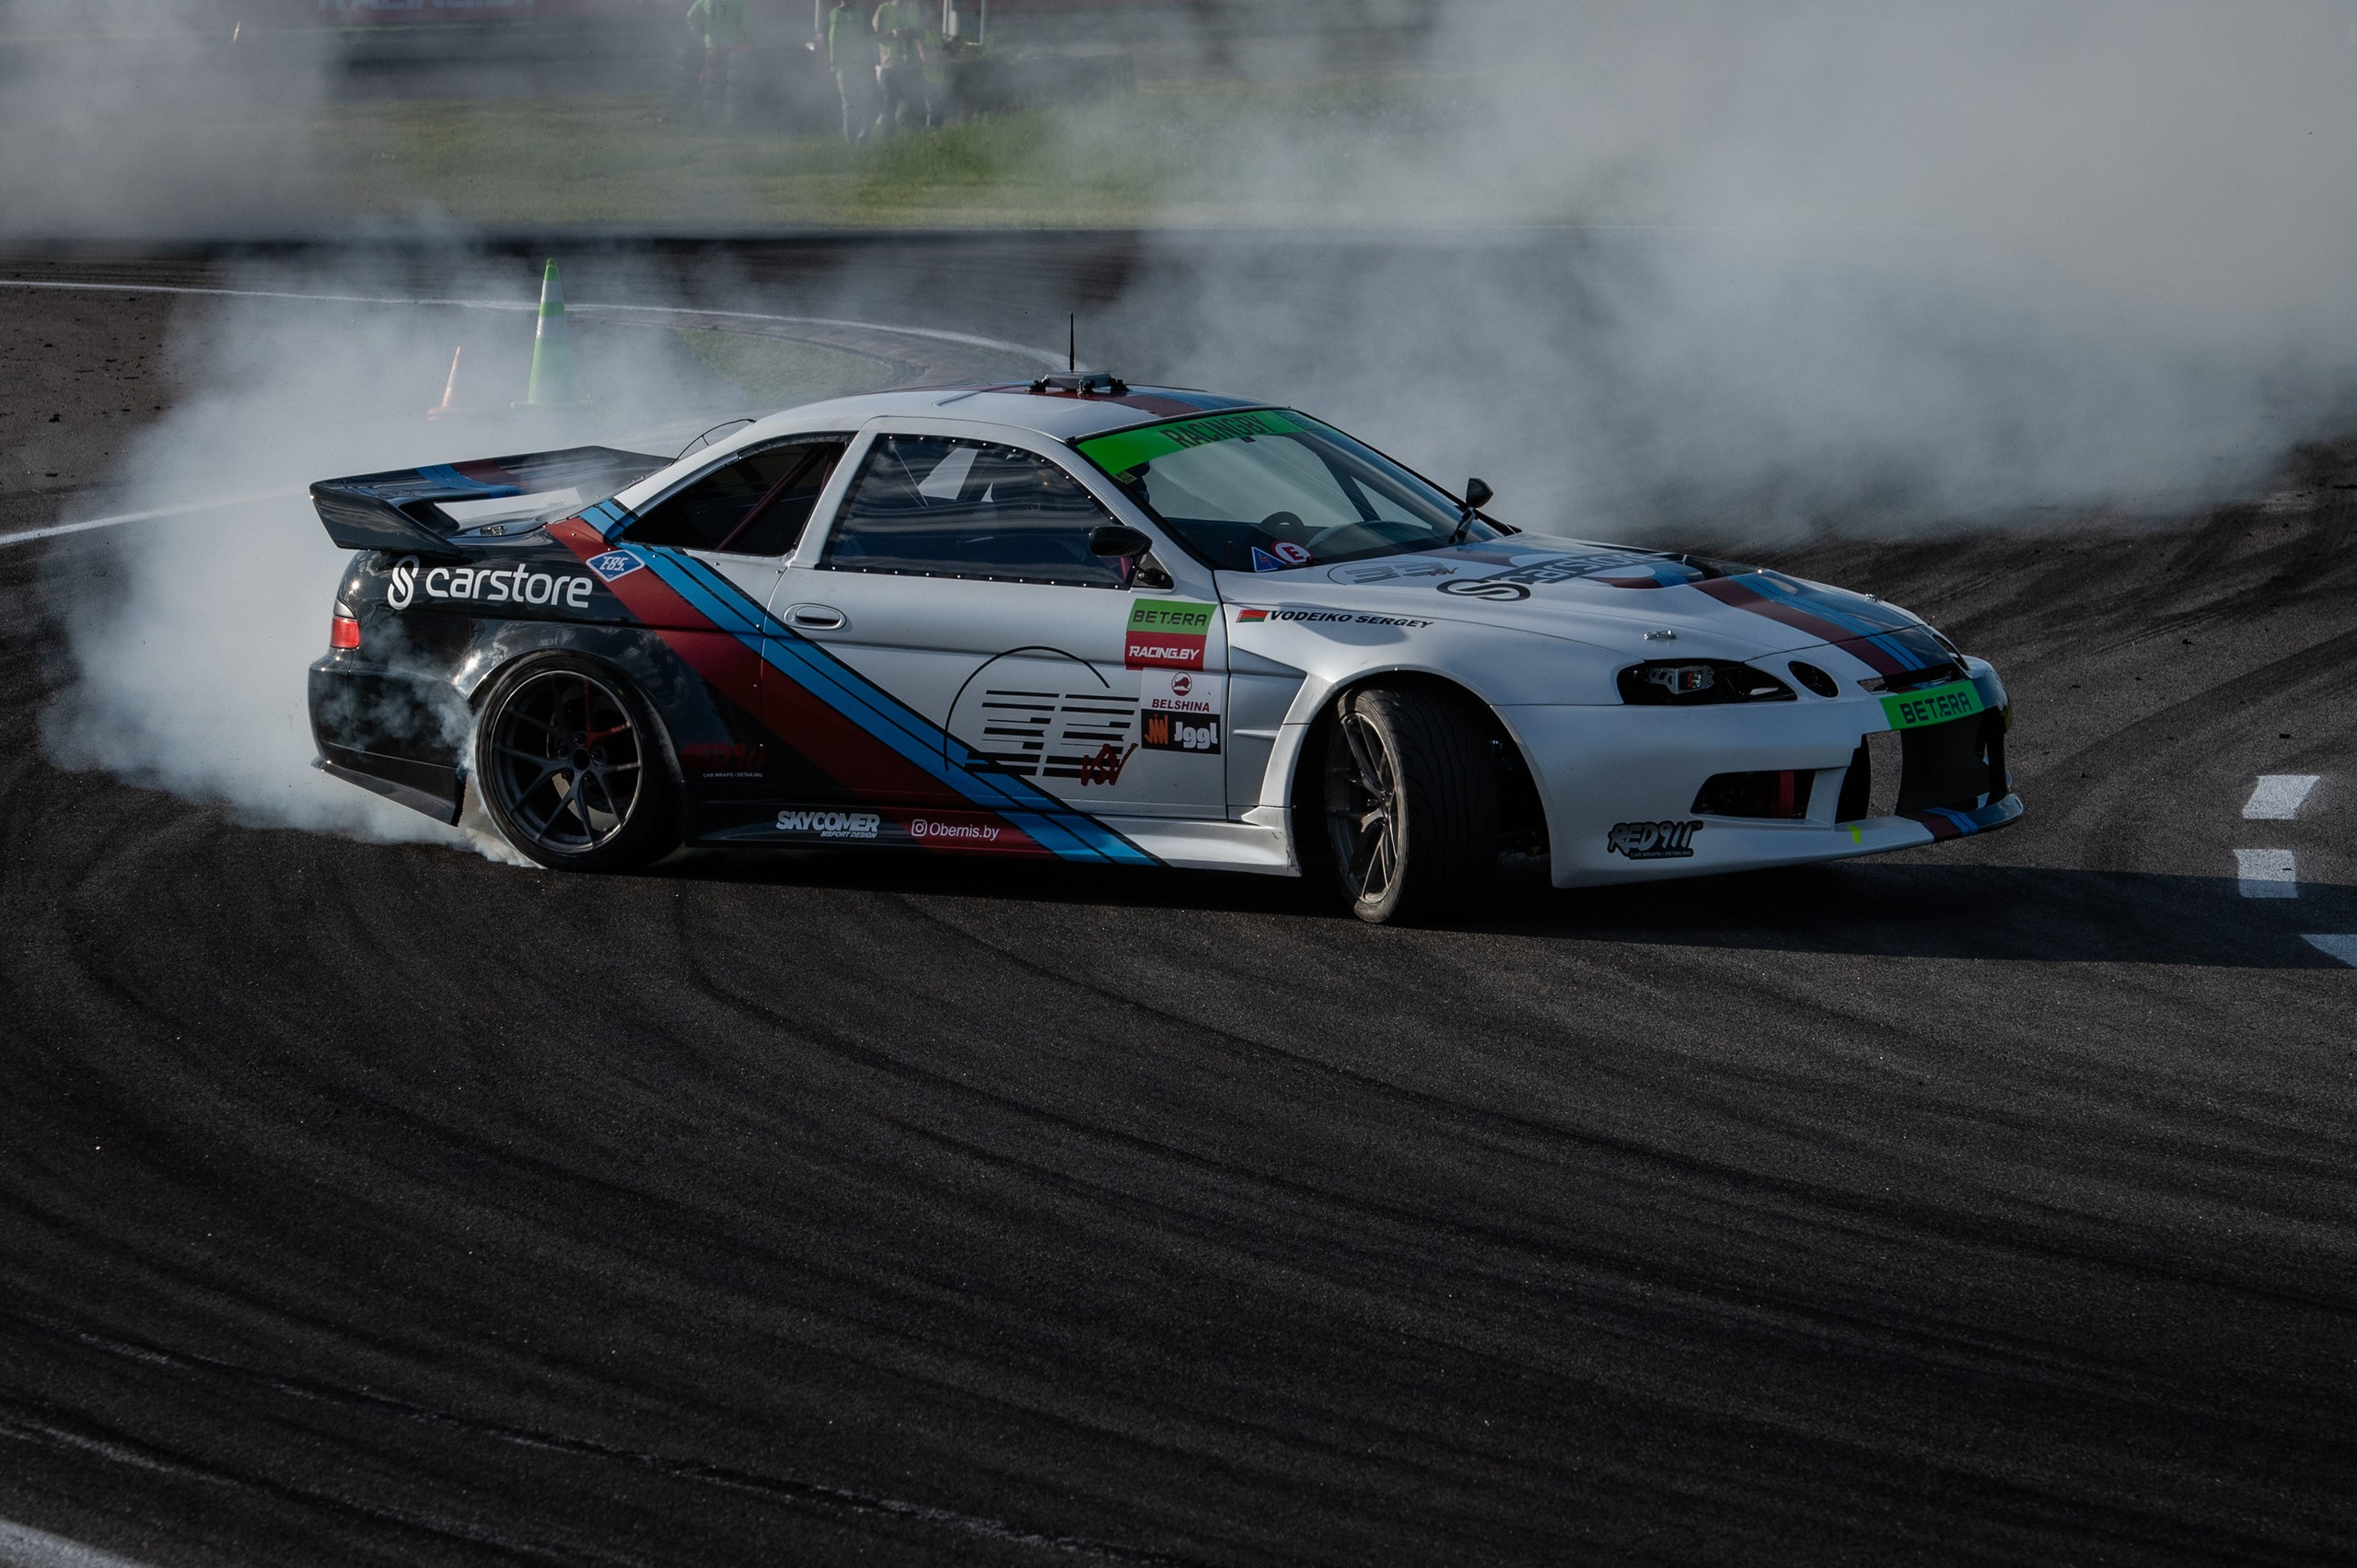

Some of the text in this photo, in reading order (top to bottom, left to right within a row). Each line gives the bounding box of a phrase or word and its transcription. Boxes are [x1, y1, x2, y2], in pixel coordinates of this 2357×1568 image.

[425, 563, 593, 609] carstore
[1269, 610, 1434, 629] VODEIKO SERGEY
[1129, 645, 1200, 660] RACING.BY
[1152, 698, 1210, 712] BELSHINA
[1174, 721, 1218, 749] Jggl
[775, 810, 881, 832] SKYCOMER
[929, 822, 1000, 842] Obernis.by
